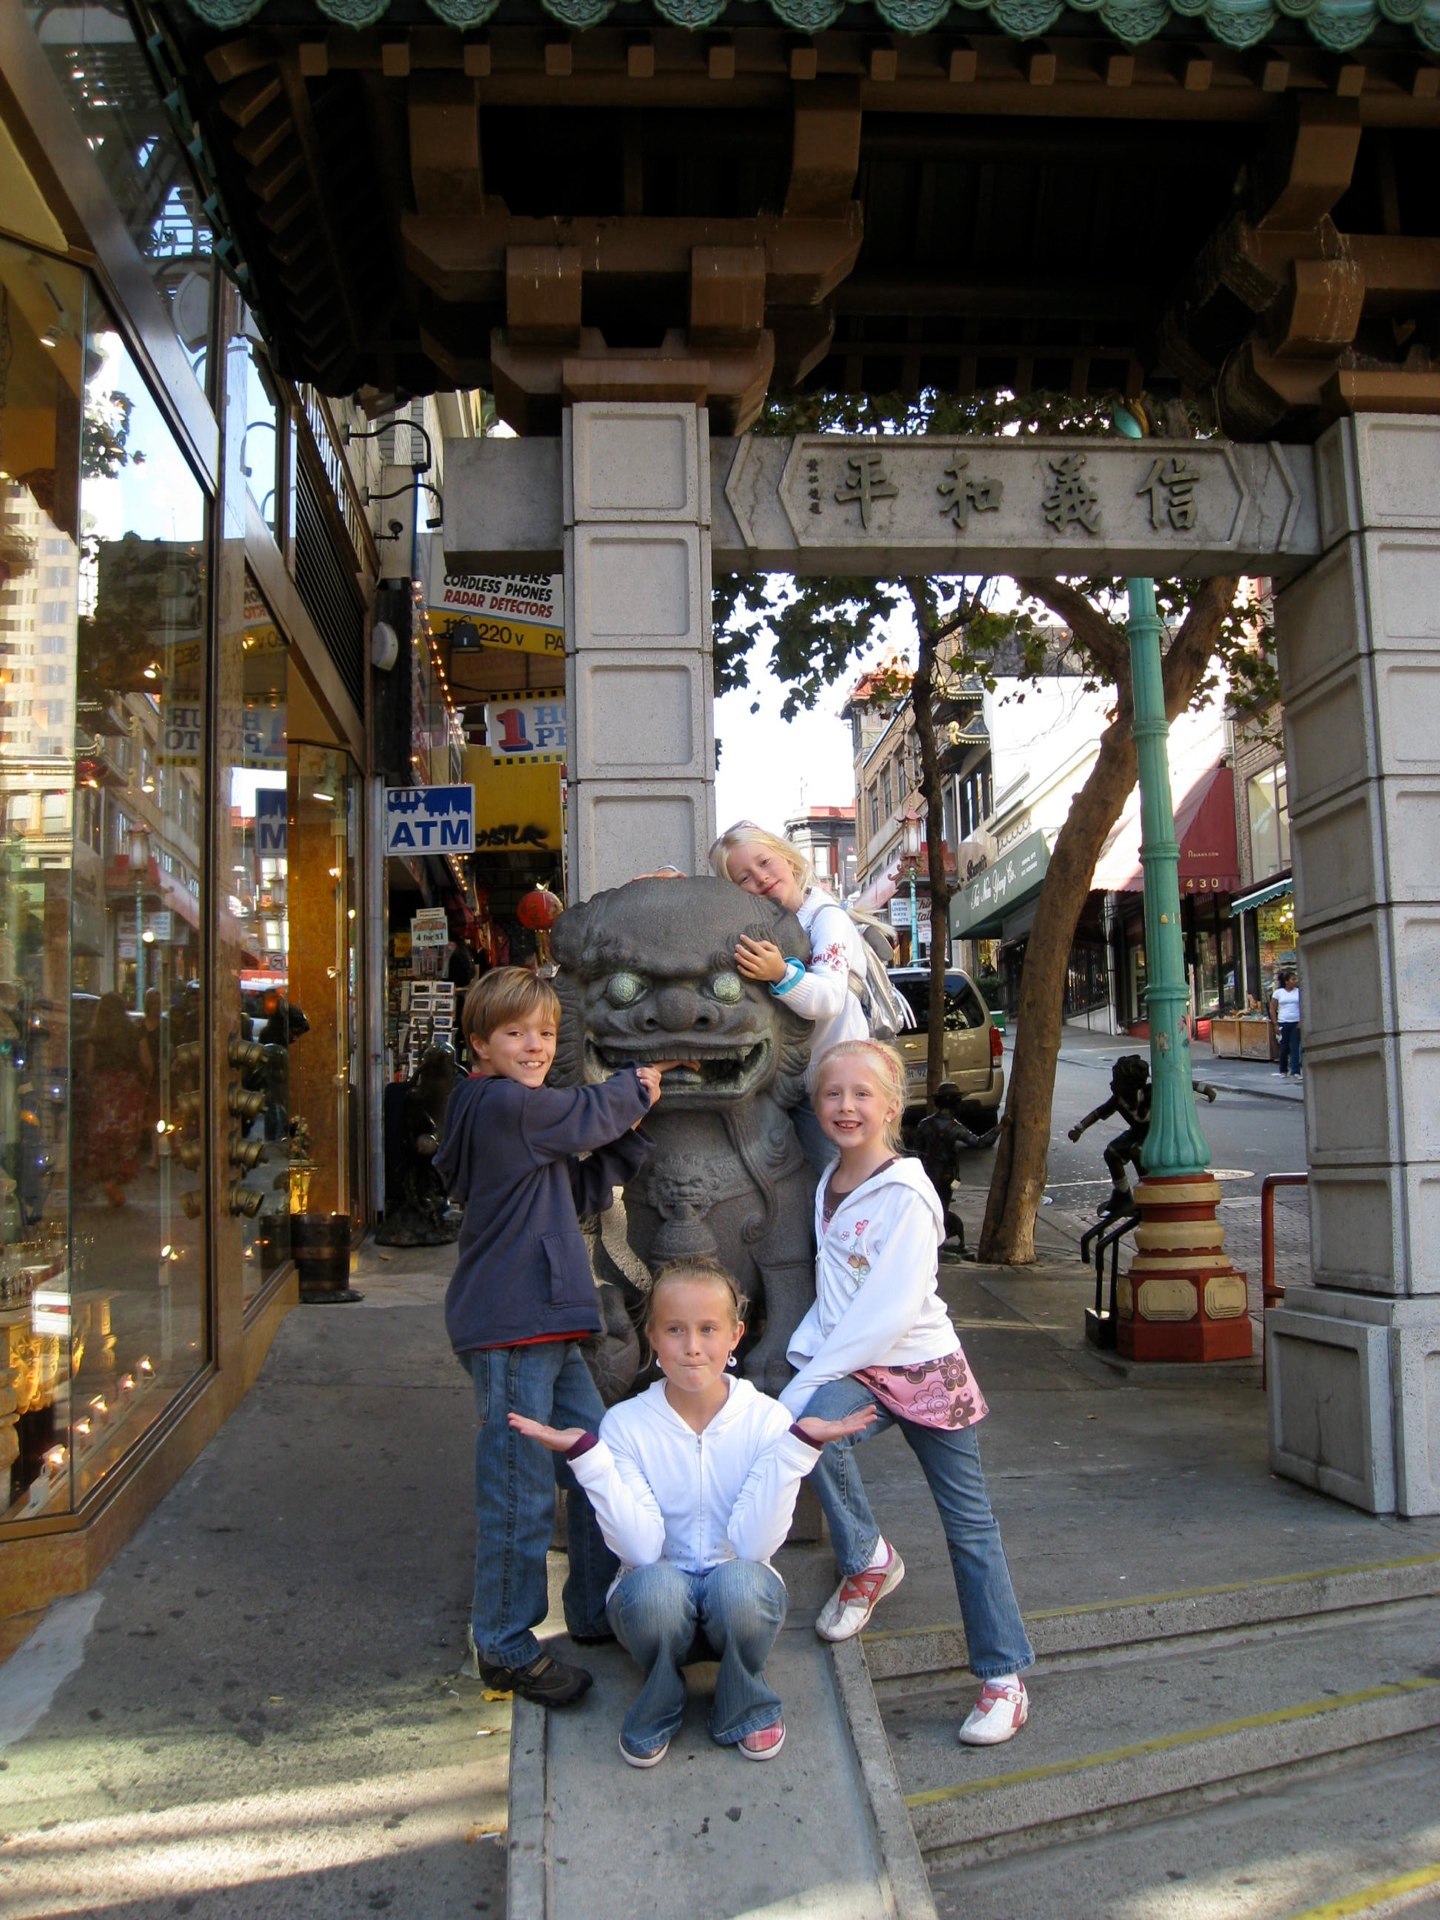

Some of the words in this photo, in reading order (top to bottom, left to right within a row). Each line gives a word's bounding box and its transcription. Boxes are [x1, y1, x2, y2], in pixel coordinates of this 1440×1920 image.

[443, 575, 502, 594] CORDLESS
[504, 583, 553, 602] PHONES
[443, 589, 486, 608] RADAR
[489, 596, 554, 618] DETECTORS
[496, 707, 534, 752] 1
[534, 704, 566, 726] H
[388, 790, 429, 803] CITY
[389, 819, 470, 848] ATM
[1186, 878, 1219, 888] 430
